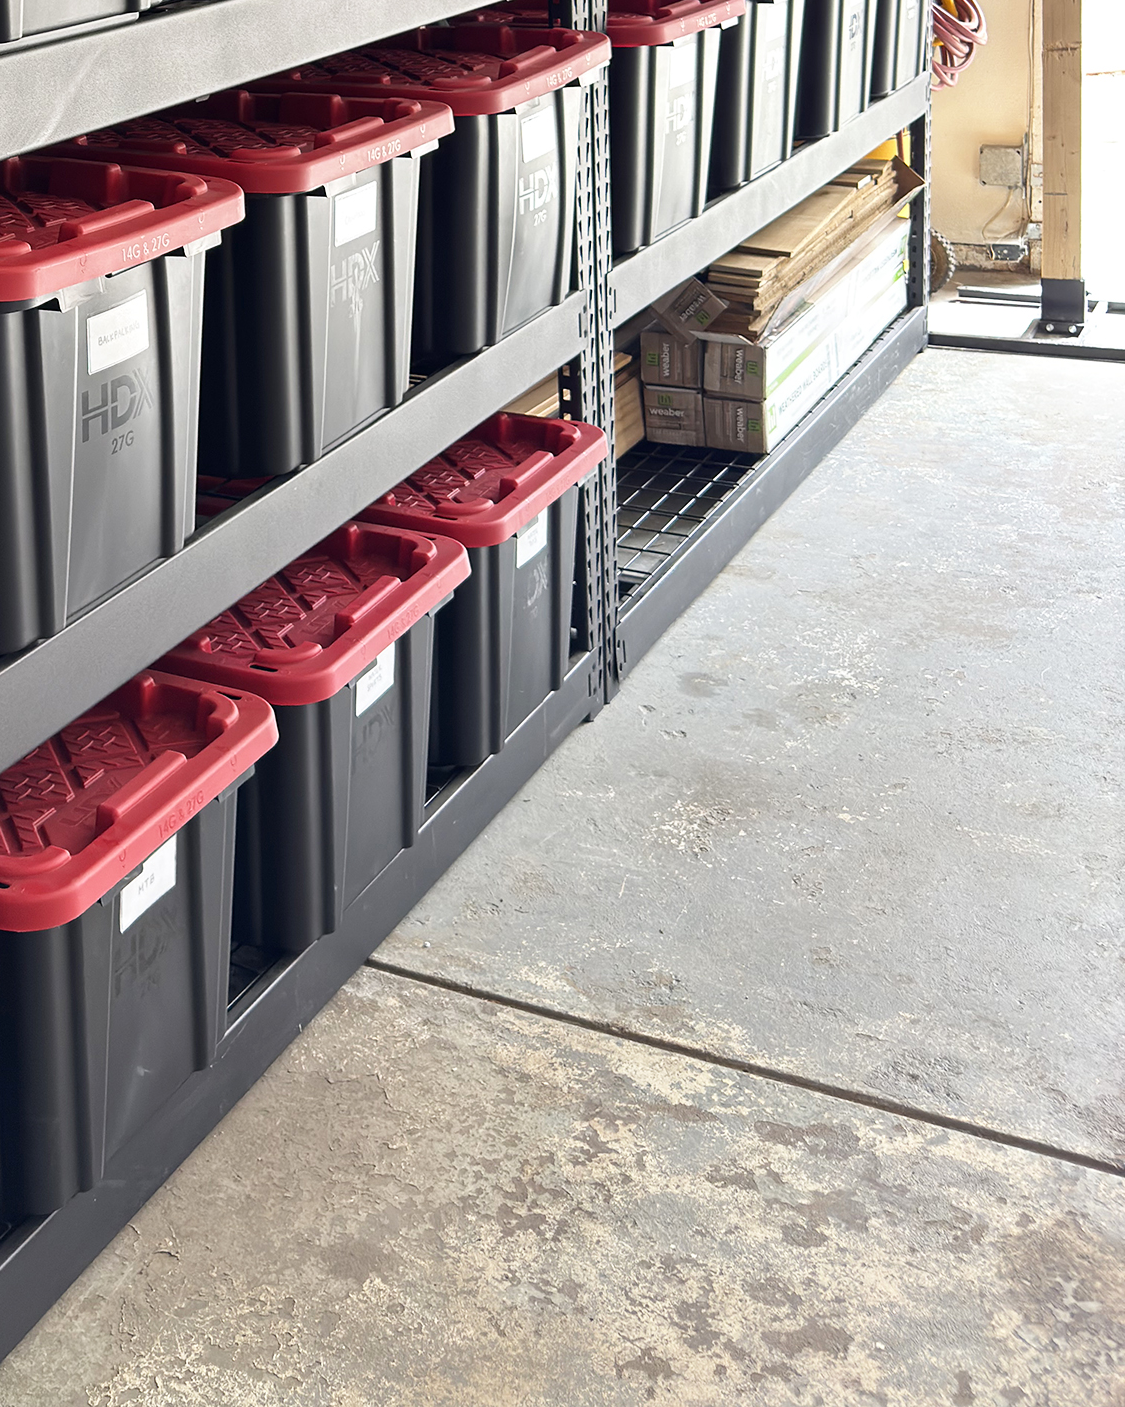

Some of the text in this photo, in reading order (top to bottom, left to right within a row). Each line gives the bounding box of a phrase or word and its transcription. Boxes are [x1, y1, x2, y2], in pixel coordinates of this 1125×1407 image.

[367, 138, 401, 162] 14G & 27G
[518, 162, 559, 215] HDX
[533, 210, 548, 226] 27G
[122, 233, 171, 262] 14G & 27G
[330, 240, 380, 308] HDX
[679, 295, 706, 322] weaber
[661, 343, 670, 377] weaber
[734, 348, 744, 384] weaber
[81, 367, 154, 443] HDX
[649, 407, 685, 417] weaber
[736, 407, 744, 442] weaber
[111, 430, 135, 455] 27G
[158, 791, 204, 838] 14G & 27G
[137, 873, 156, 895] MTB
